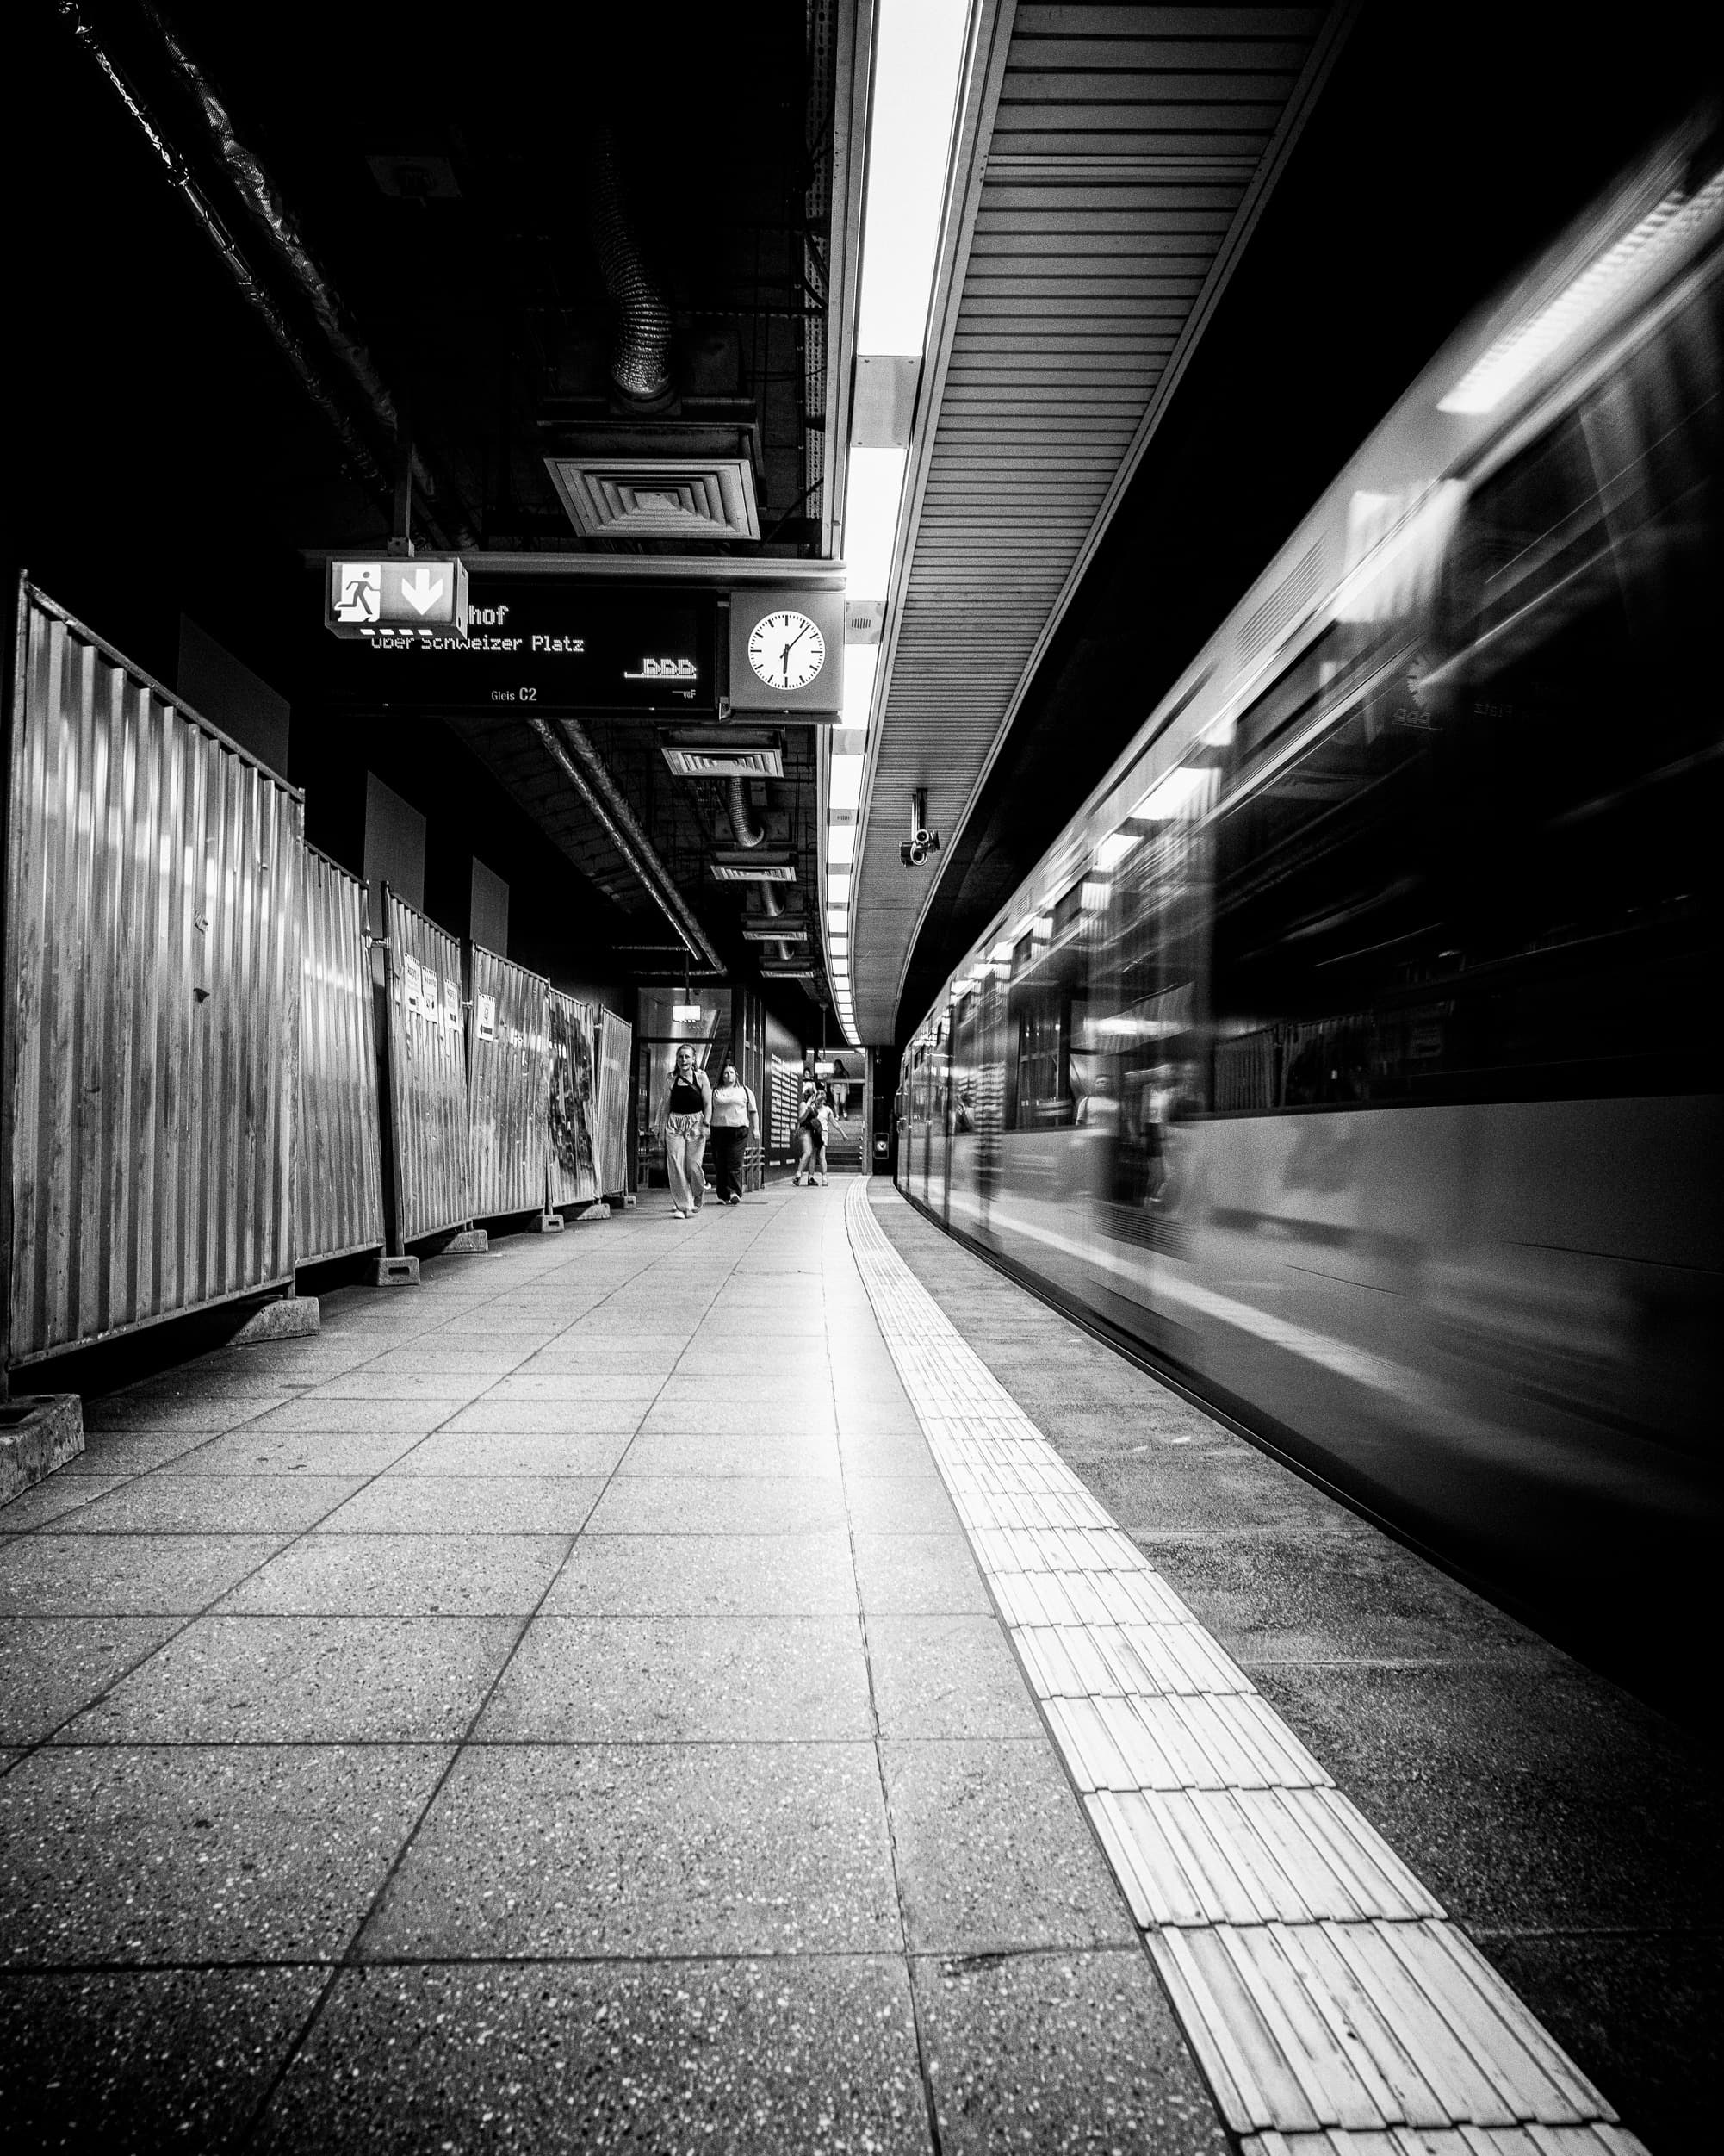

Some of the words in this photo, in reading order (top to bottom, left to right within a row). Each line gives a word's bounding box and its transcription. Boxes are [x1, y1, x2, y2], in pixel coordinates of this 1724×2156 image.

[421, 634, 523, 652] Schweizer
[531, 634, 586, 653] Platz
[491, 690, 515, 701] Gleis
[518, 687, 537, 702] C2
